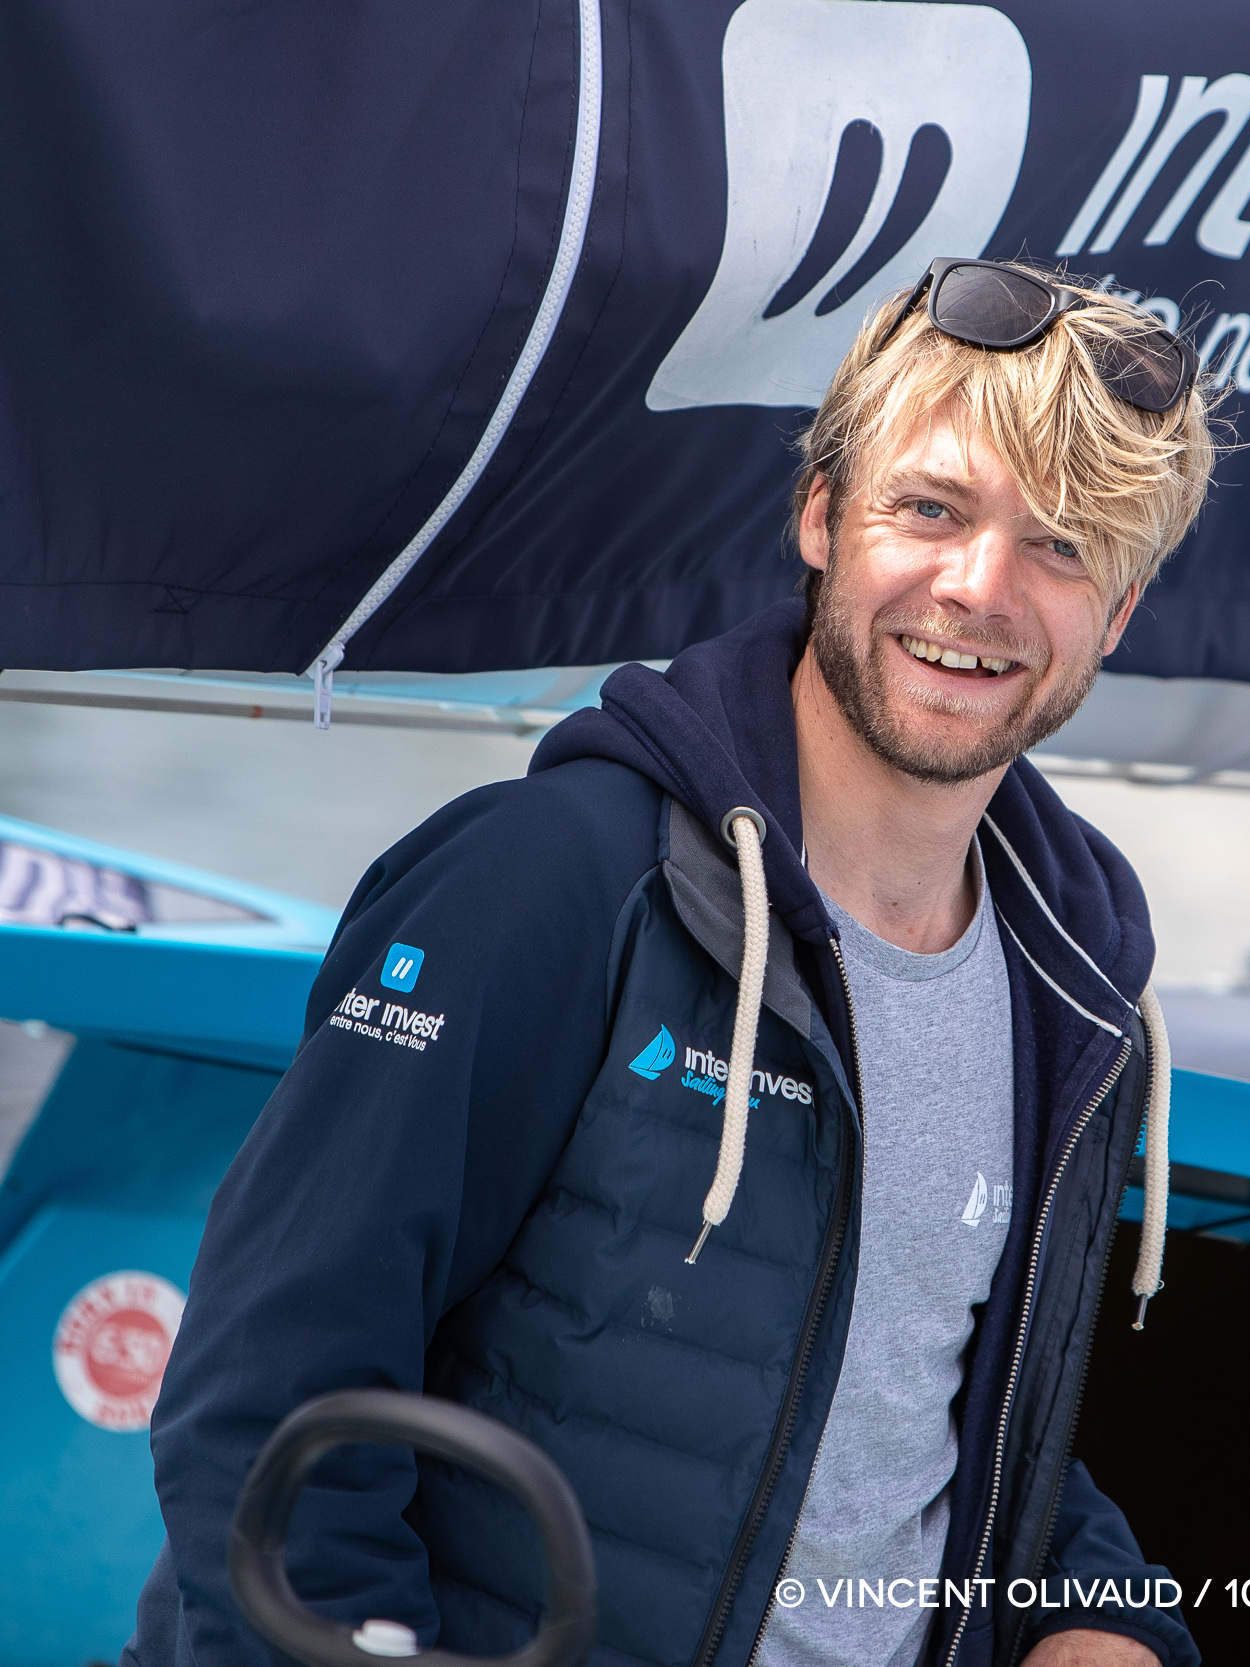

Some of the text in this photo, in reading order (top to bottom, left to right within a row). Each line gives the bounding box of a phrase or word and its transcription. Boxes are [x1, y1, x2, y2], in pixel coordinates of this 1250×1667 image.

[329, 1015, 427, 1051] entre nous, c'est Vous
[334, 987, 445, 1041] ter invest
[684, 1046, 815, 1110] inte nves
